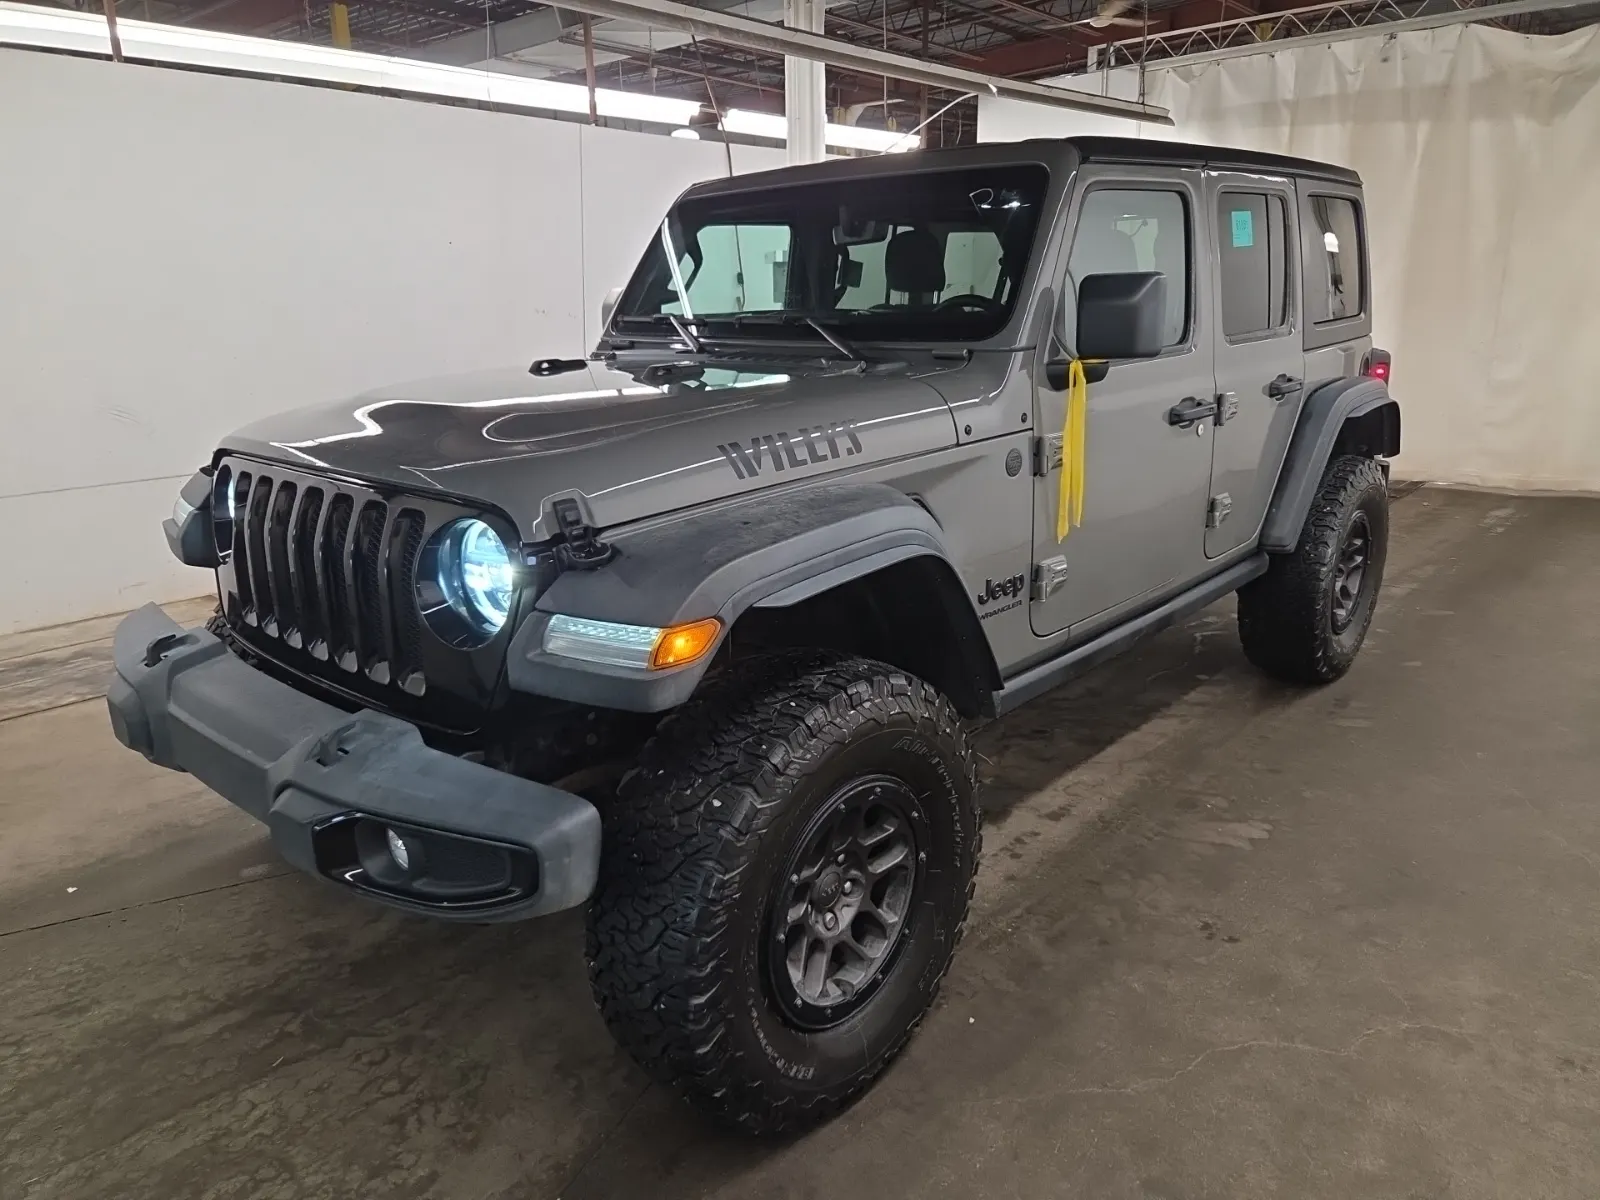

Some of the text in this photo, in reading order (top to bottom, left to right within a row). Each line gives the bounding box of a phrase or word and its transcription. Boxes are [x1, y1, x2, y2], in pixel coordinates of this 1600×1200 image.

[717, 418, 863, 480] WILLYS
[978, 573, 1025, 605] Jeep
[979, 600, 1023, 620] WRANGLER
